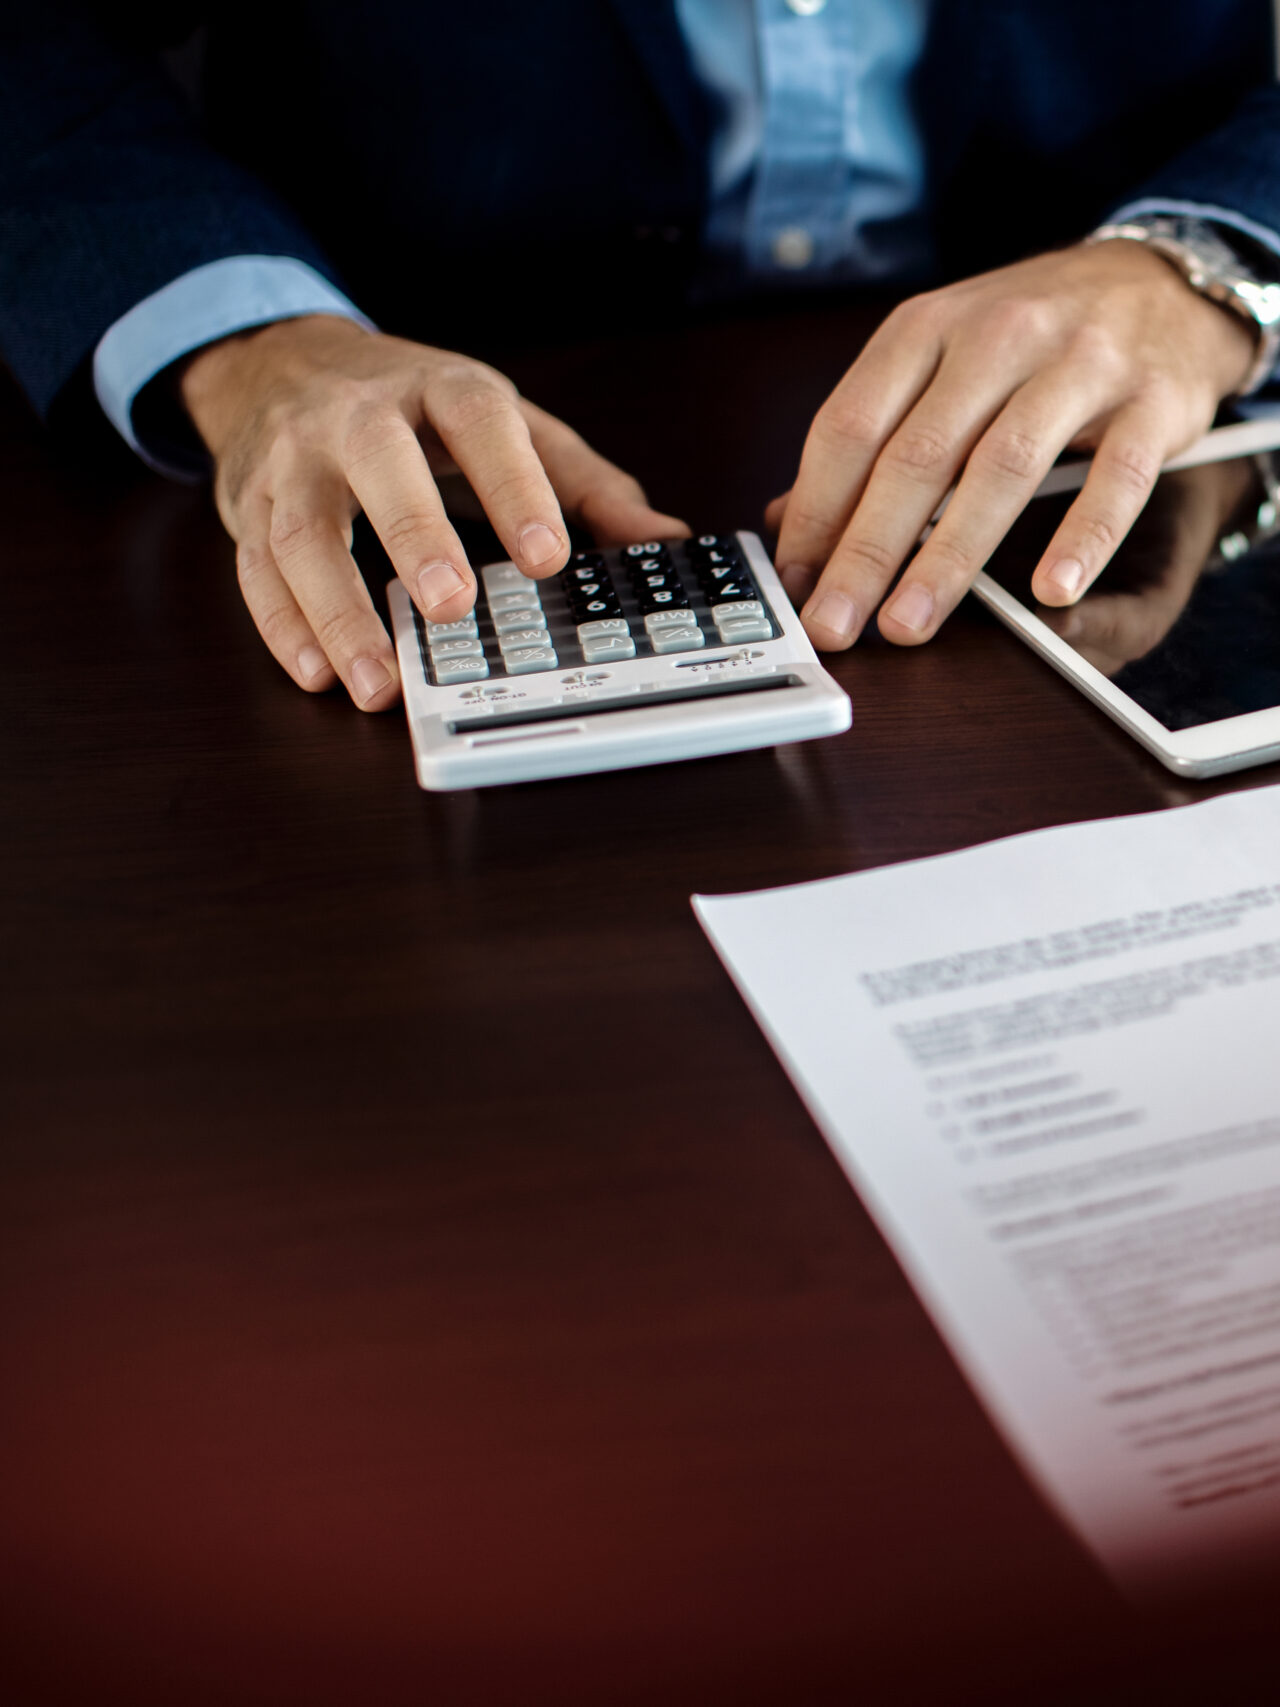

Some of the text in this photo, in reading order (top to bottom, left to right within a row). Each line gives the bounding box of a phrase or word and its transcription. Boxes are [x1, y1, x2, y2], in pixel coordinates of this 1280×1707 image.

[698, 535, 717, 546] 0
[627, 542, 661, 556] 00
[709, 551, 723, 562] 1
[641, 559, 660, 571] 2
[575, 567, 595, 579] 3
[711, 567, 731, 579] 4
[647, 575, 665, 588] 5
[580, 583, 600, 595] 6
[720, 583, 741, 595] 7
[653, 591, 673, 603] 8
[586, 600, 607, 611] 9
[719, 602, 756, 614] MC
[653, 611, 688, 621] MR
[440, 640, 472, 652] GT
